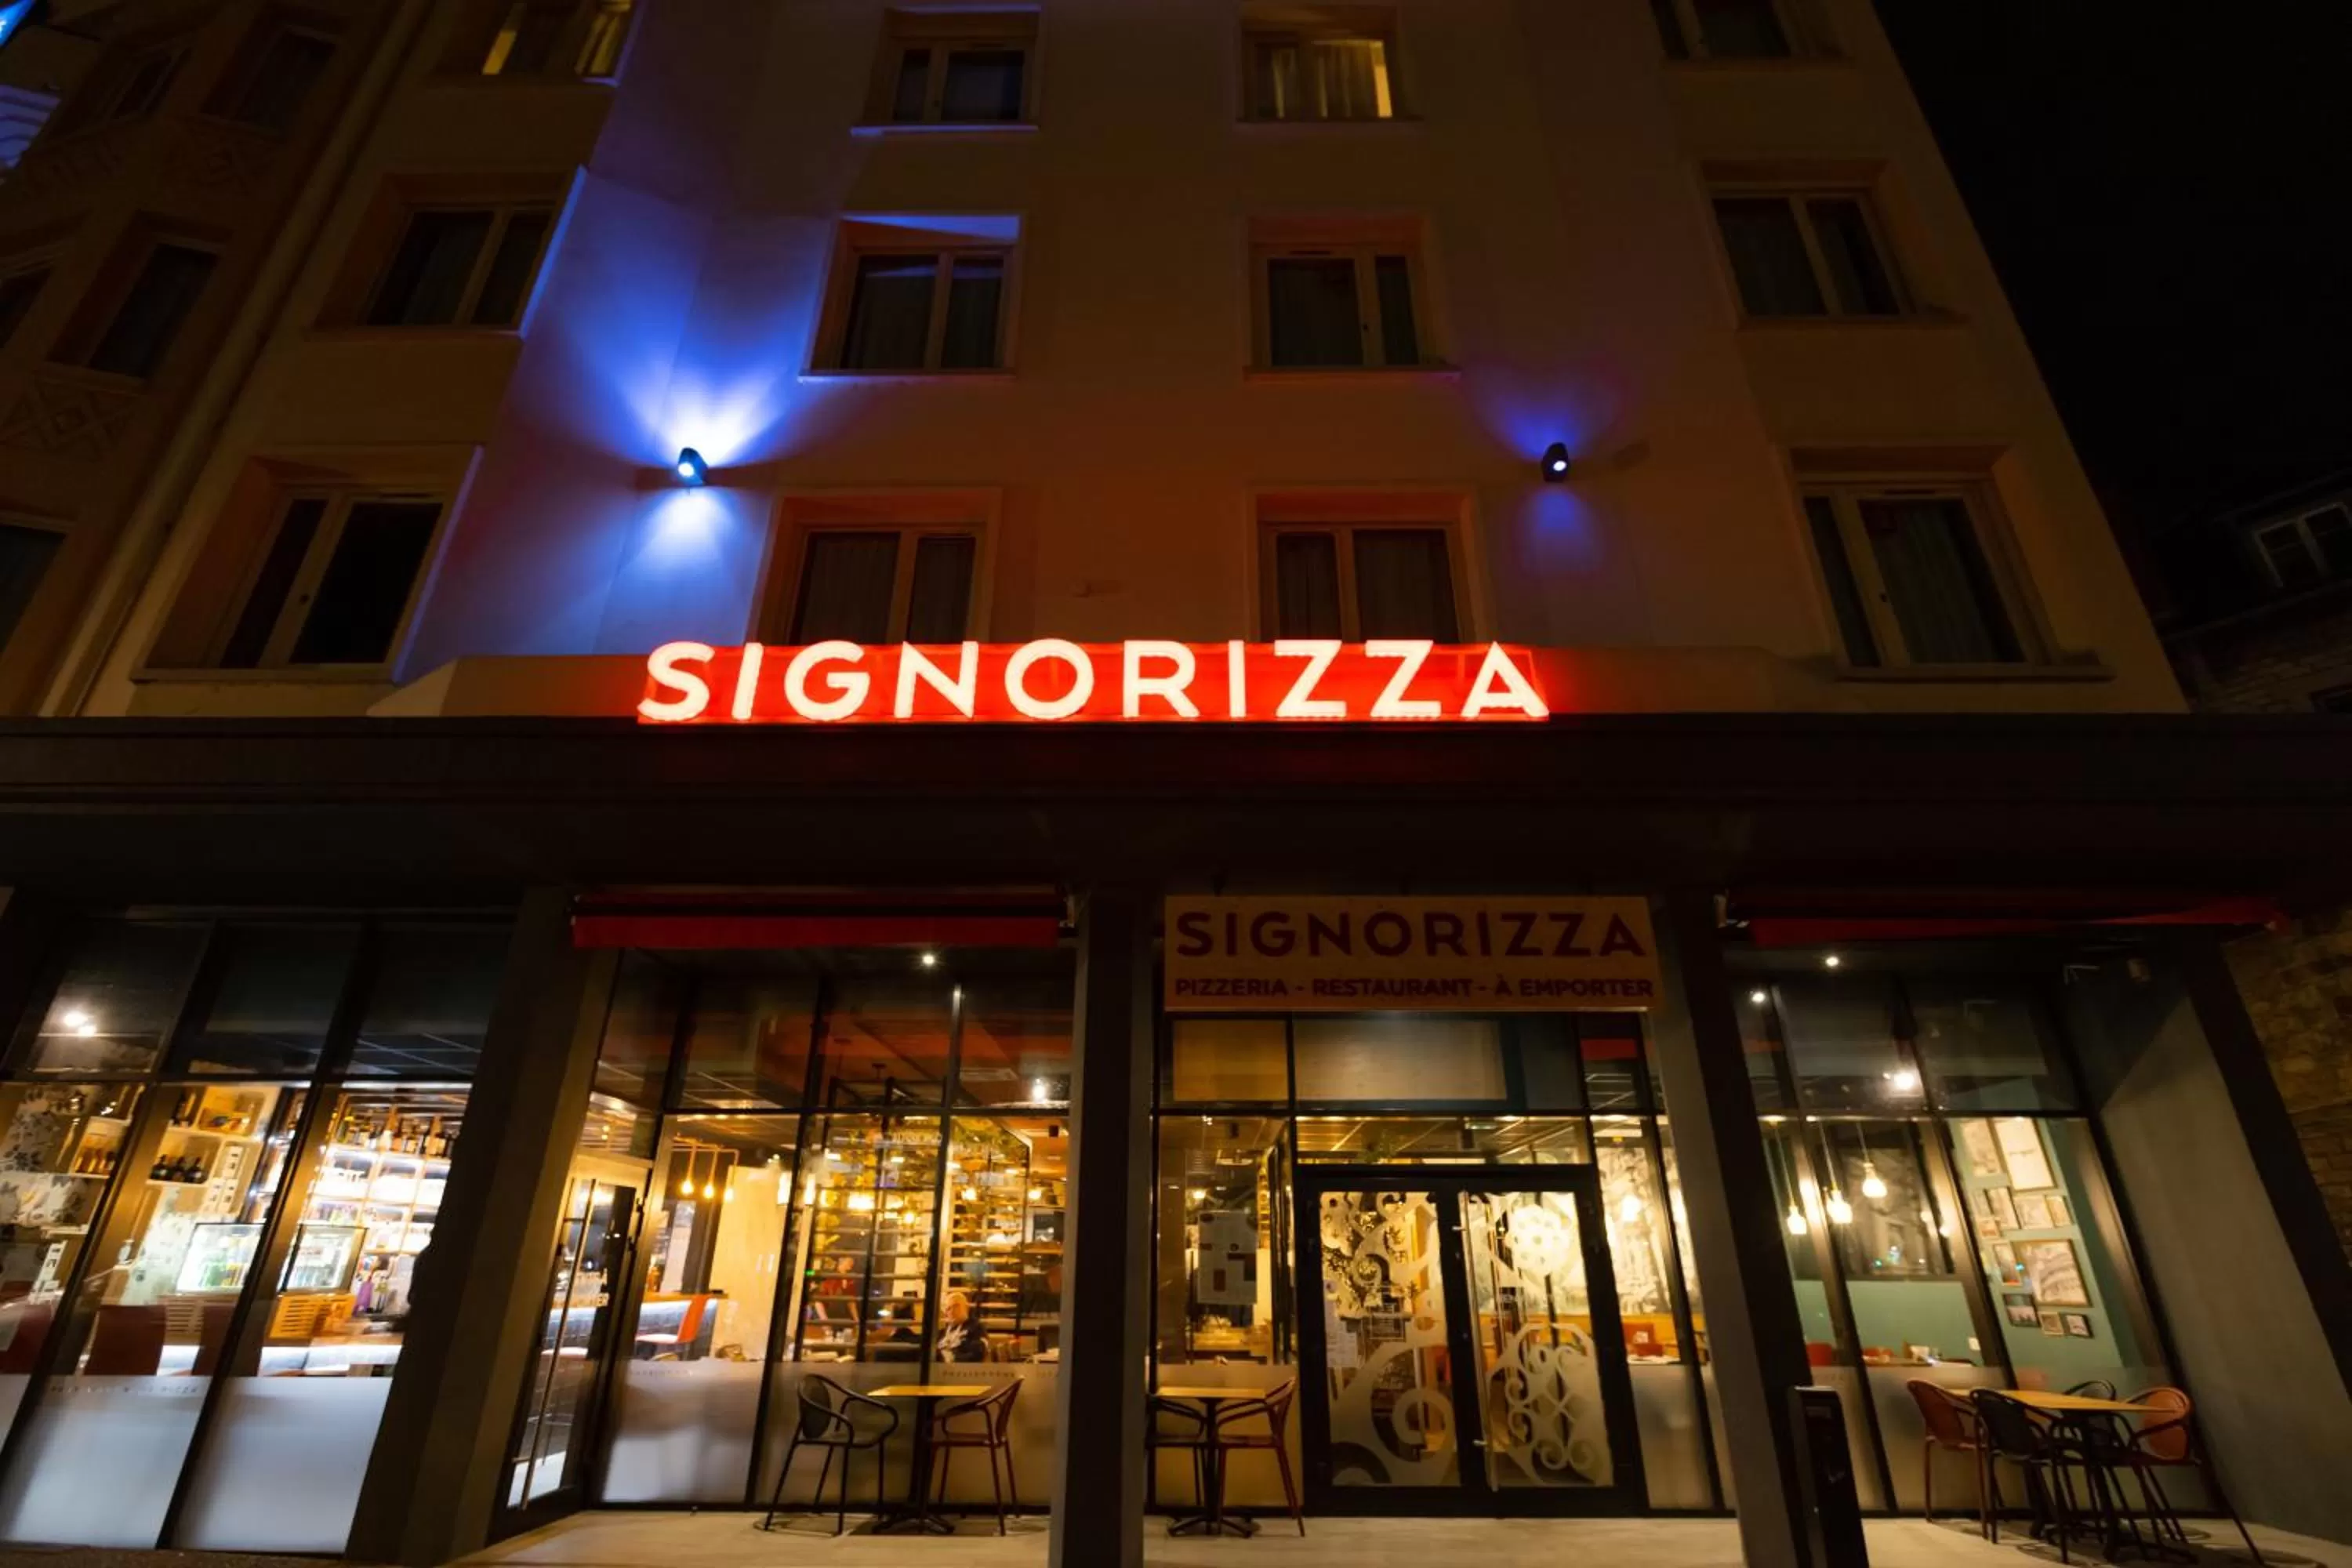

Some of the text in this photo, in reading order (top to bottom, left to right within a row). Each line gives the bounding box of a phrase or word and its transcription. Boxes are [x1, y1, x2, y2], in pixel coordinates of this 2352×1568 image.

[637, 639, 1550, 722] SIGNORIZZA
[1176, 911, 1647, 957] SIGNORIZZA
[1175, 978, 1290, 997] PIZZERIA
[1312, 978, 1473, 998] RESTAURANT
[1494, 973, 1514, 997] À
[1518, 978, 1654, 998] EMPORTER
